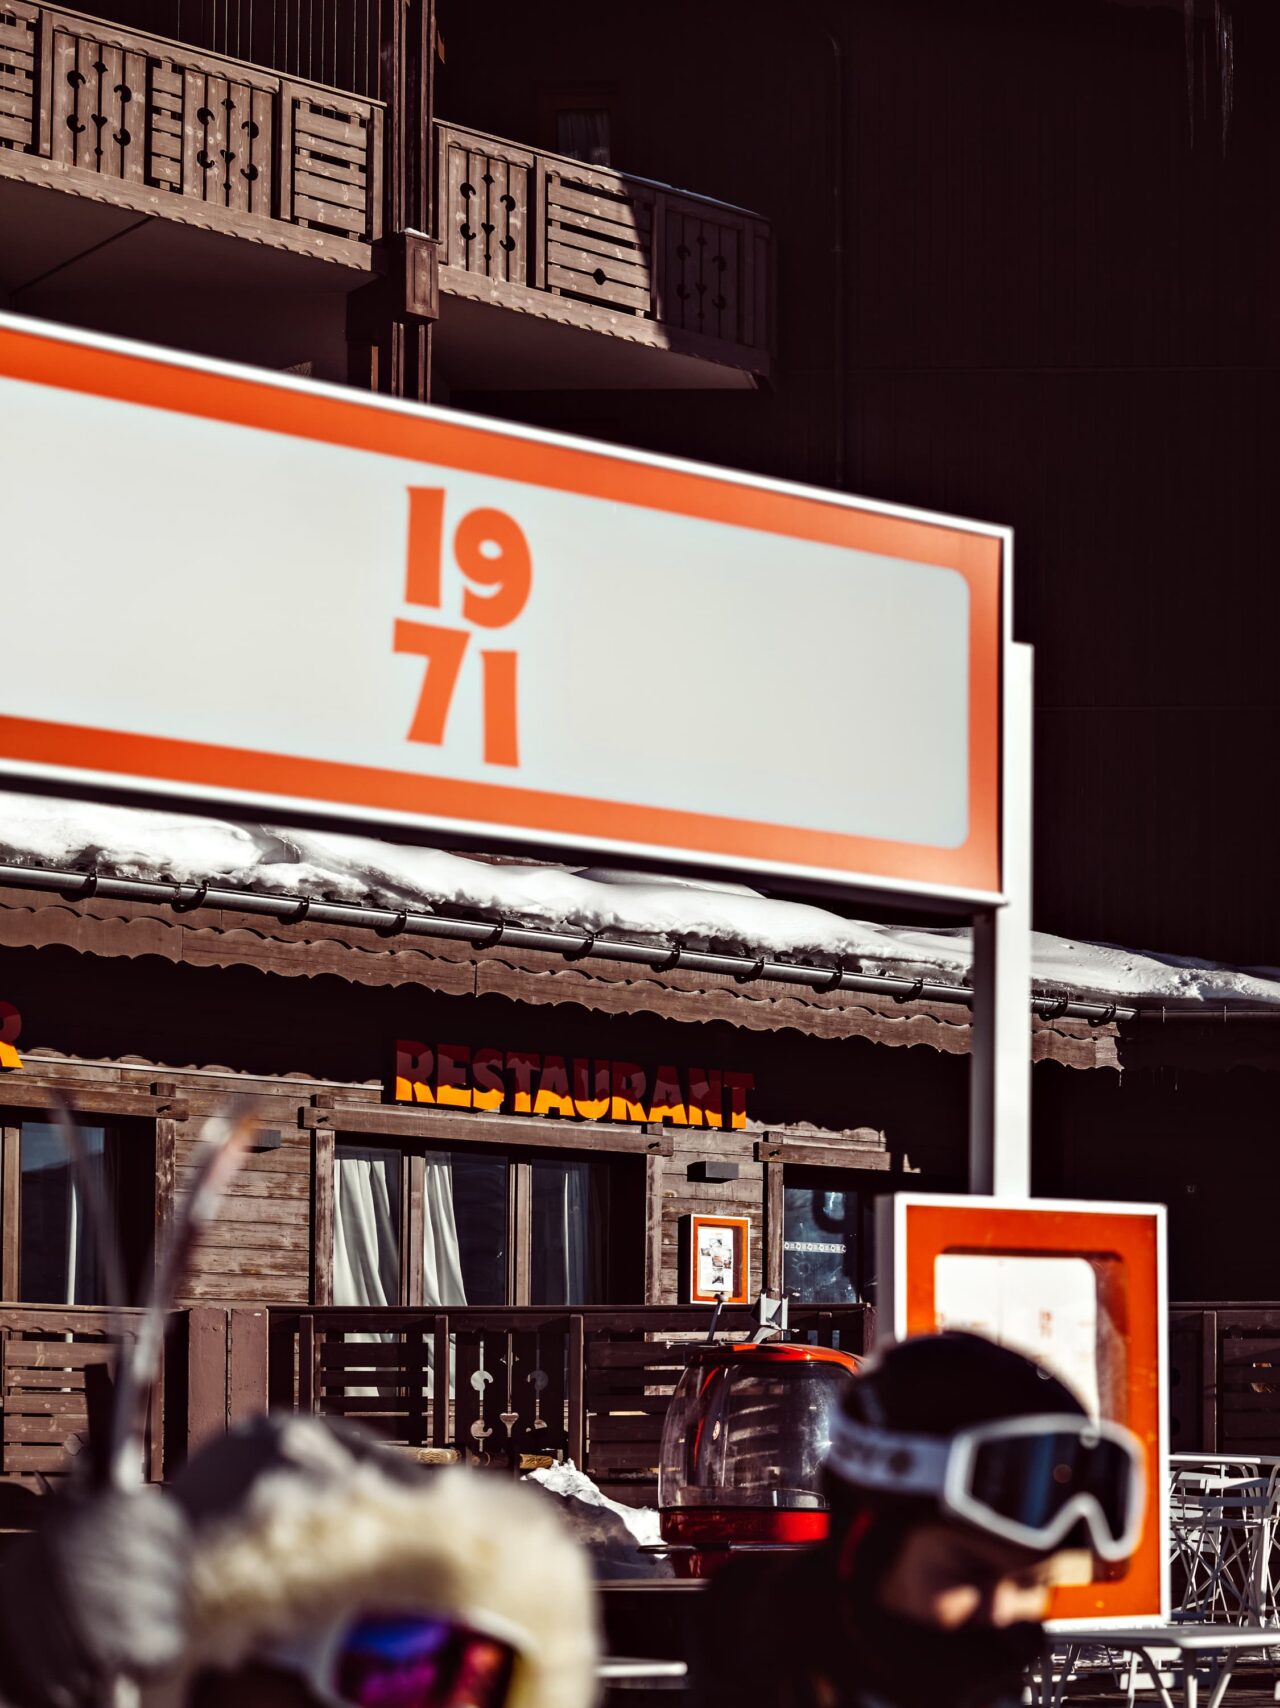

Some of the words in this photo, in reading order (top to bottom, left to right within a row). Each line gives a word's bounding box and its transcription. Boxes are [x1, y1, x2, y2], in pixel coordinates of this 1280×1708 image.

[403, 484, 534, 630] 19
[391, 616, 520, 769] 71
[395, 1039, 754, 1130] RESTAURANT
